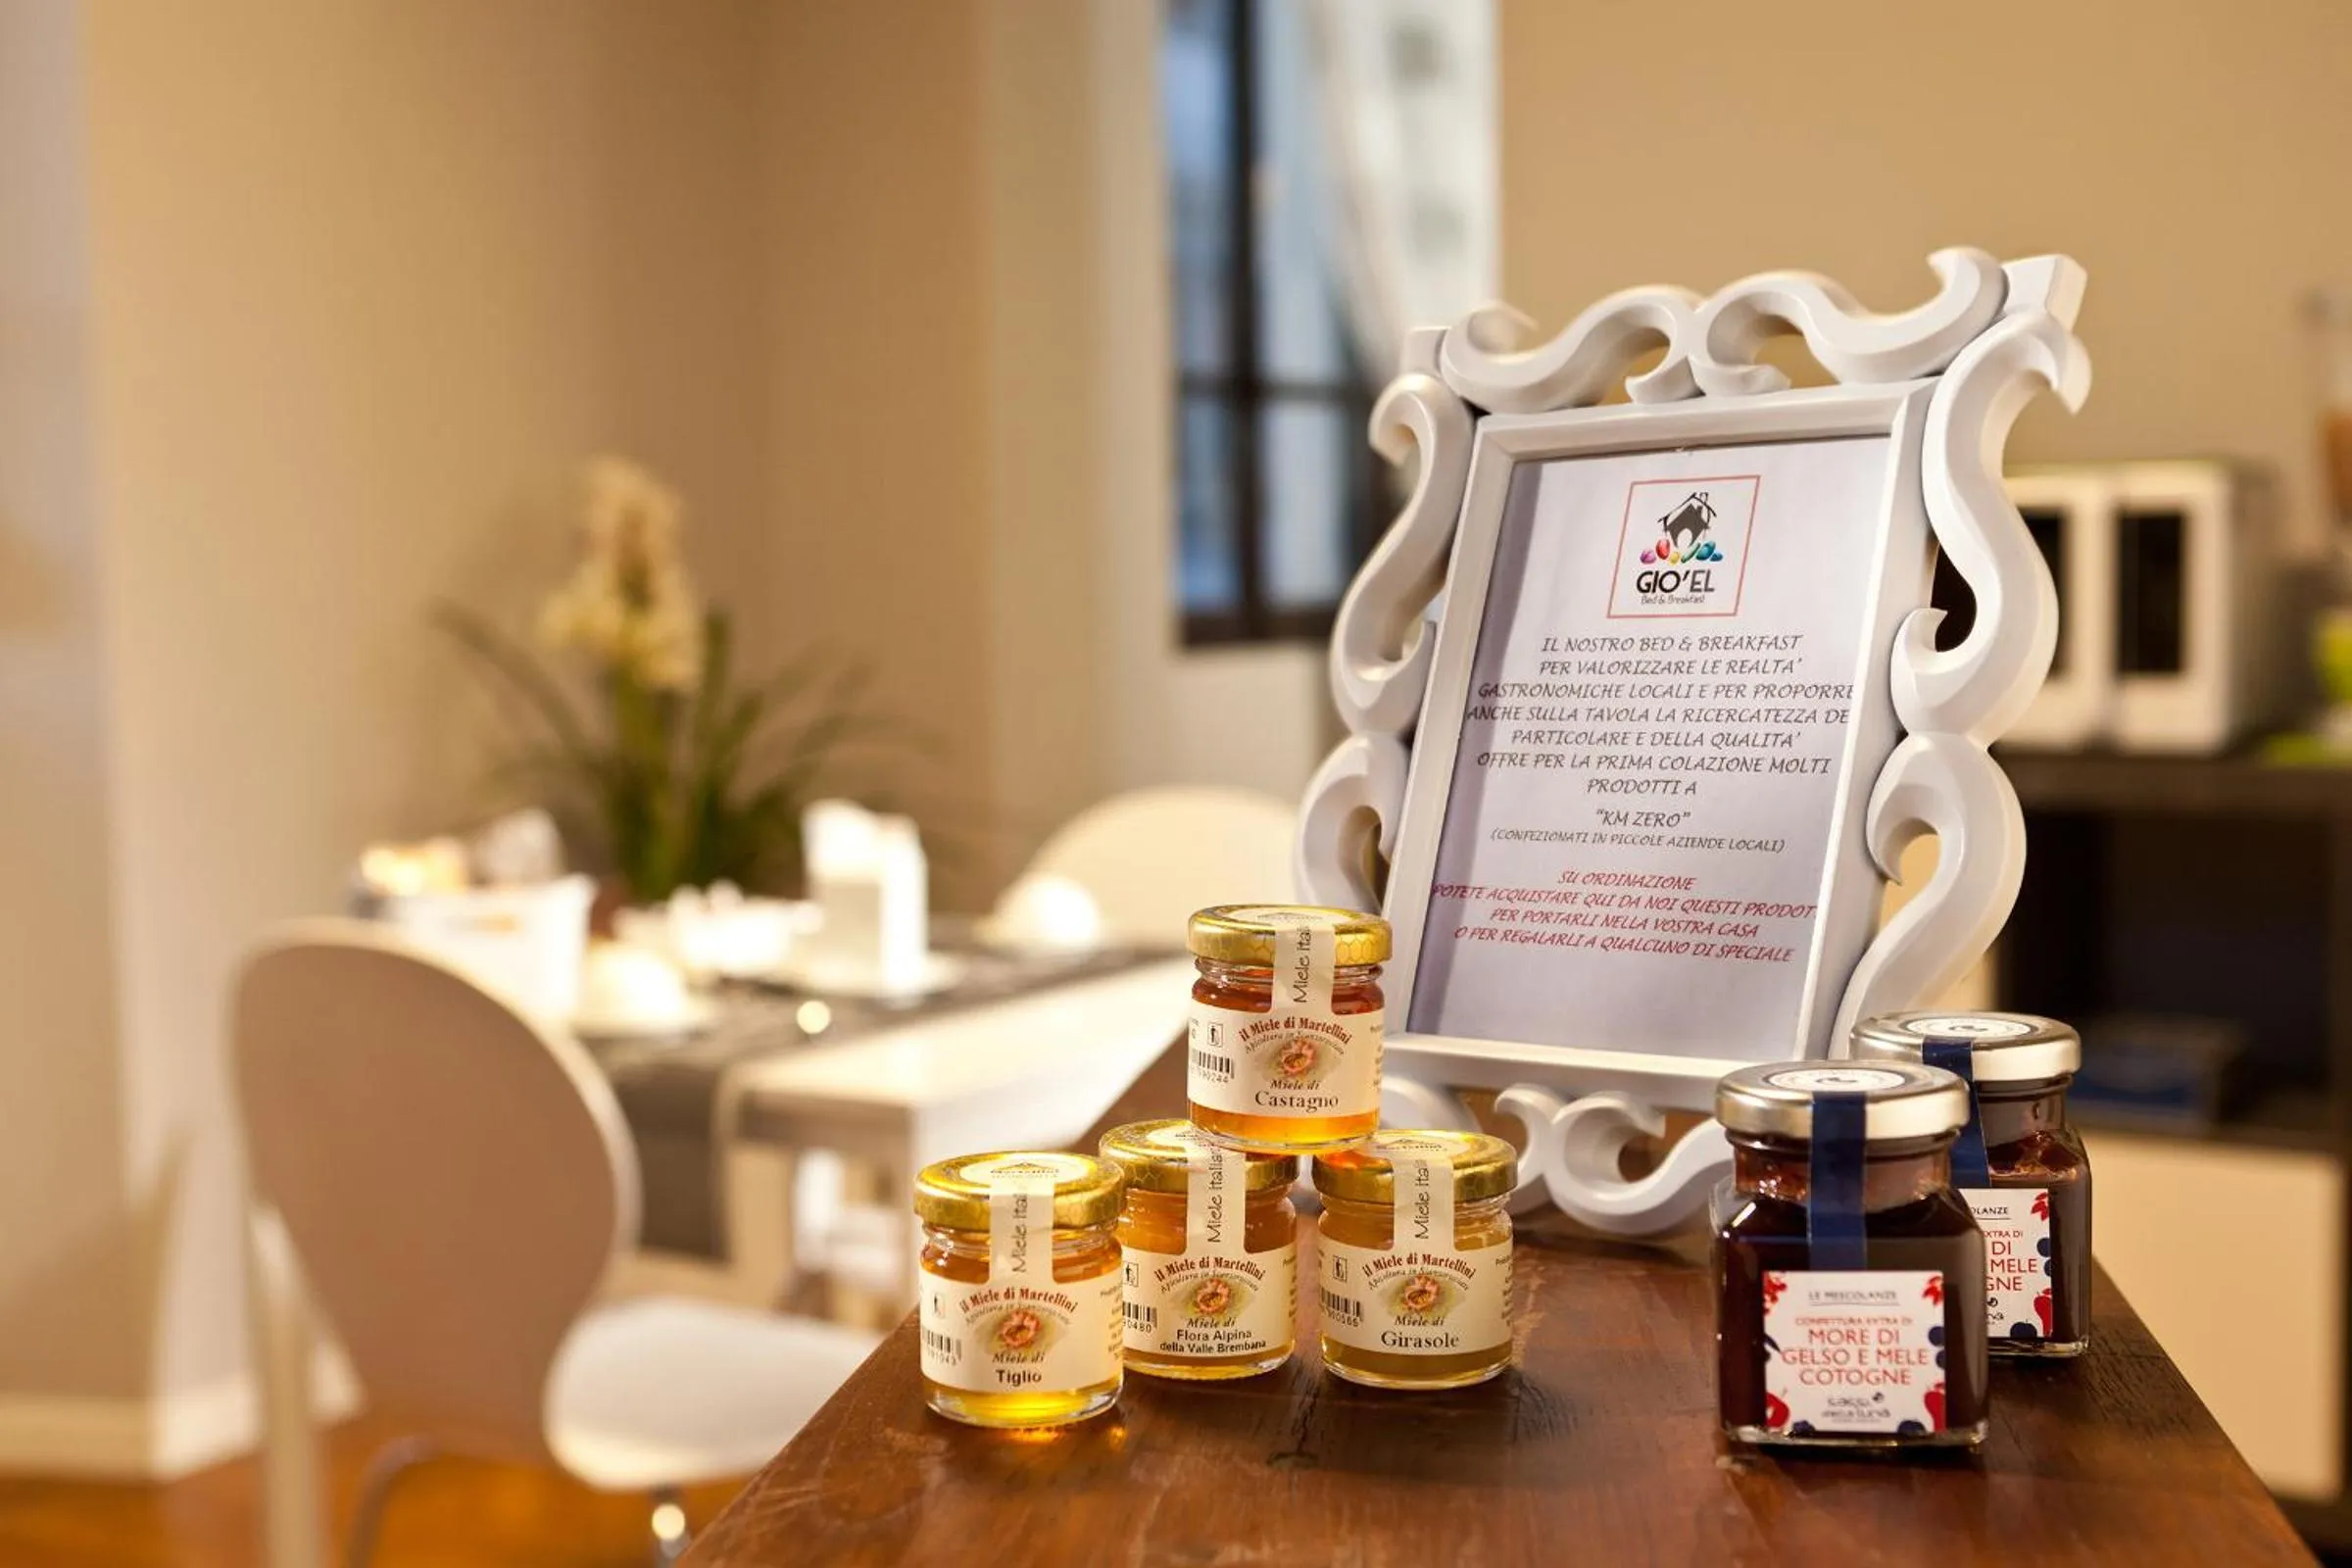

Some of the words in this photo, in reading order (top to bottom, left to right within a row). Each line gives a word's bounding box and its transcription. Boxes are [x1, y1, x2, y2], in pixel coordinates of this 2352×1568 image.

[1636, 569, 1715, 594] GIO'EL
[1641, 595, 1657, 605] Bed
[1658, 595, 1666, 604] &
[1667, 595, 1705, 604] Breakfast
[1542, 637, 1558, 652] IL
[1565, 636, 1634, 653] NOSTRO
[1640, 636, 1675, 652] BED
[1679, 637, 1692, 652] &
[1698, 634, 1803, 652] BREAKFAST
[1540, 660, 1572, 675] PER
[1577, 659, 1696, 675] VALORIZZARE
[1700, 659, 1722, 675] LE
[1478, 682, 1625, 699] GASTRONOMICHE
[1628, 683, 1693, 699] LOCALI
[1698, 684, 1709, 699] E
[1714, 684, 1747, 700] PER
[1466, 706, 1525, 721] ANCHE
[1526, 706, 1578, 721] SULLA
[1585, 707, 1648, 722] TAVOLA
[1655, 707, 1676, 722] LA
[1682, 708, 1816, 724] RICERCATEZZA
[1511, 729, 1633, 746] PARTICOLARE
[1636, 731, 1647, 745] E
[1650, 731, 1704, 747] DELLA
[1477, 752, 1531, 768] OFFRE
[1533, 754, 1566, 768] PER
[1570, 755, 1591, 769] LA
[1595, 755, 1652, 770] PRIMA
[1658, 756, 1764, 772] COLAZIONE
[1768, 757, 1832, 774] MOLTI
[1587, 778, 1682, 795] PRODOTTI
[1685, 781, 1697, 796] A
[1491, 827, 1590, 844] (CONFEZIONATI
[1592, 832, 1607, 844] IN
[1609, 833, 1664, 847] PICCOLE
[1666, 835, 1726, 850] AZIENDE
[1729, 838, 1786, 854] LOCALI)
[1557, 870, 1579, 884] SU
[1582, 872, 1696, 891] ORDINAZIONE
[1486, 887, 1581, 905] ACQUISTARE
[1584, 893, 1615, 908] QUI
[1618, 894, 1642, 908] DA
[1644, 896, 1677, 911] NOI
[1680, 898, 1742, 916] QUESTI
[1742, 902, 1818, 919] PRODOT
[1490, 907, 1520, 922] PER
[1521, 909, 1599, 927] PORTARLI
[1600, 913, 1648, 931] NELLA
[1652, 917, 1714, 936] VOSTRA
[1717, 922, 1760, 938] CASA
[1454, 926, 1468, 940] O
[1470, 928, 1495, 941] PER
[1499, 929, 1585, 948] REGALARLI
[1584, 936, 1596, 950] A
[1600, 936, 1690, 955] QUALCUNO
[1692, 942, 1716, 957] DI
[1715, 944, 1795, 962] SPECIALE
[1293, 955, 1310, 1004] Miele
[1239, 1028, 1250, 1042] il
[1250, 1018, 1280, 1035] Miele
[1284, 1016, 1296, 1028] di
[1299, 1017, 1352, 1045] Martellini
[1270, 1079, 1301, 1090] Miele
[1307, 1079, 1320, 1090] di
[1255, 1090, 1339, 1113] Castagno
[1206, 1195, 1223, 1243] Miele
[1413, 1192, 1431, 1240] Miele
[1010, 1224, 1027, 1273] Miele
[1991, 1241, 2012, 1255] DI
[1165, 1258, 1196, 1275] Miele
[1200, 1256, 1210, 1269] di
[1214, 1256, 1266, 1281] Martellini
[1362, 1263, 1372, 1277] il
[1372, 1254, 1403, 1271] Miele
[1406, 1252, 1418, 1265] di
[1422, 1253, 1477, 1280] Martellini
[1990, 1258, 2038, 1274] MELE
[970, 1289, 1000, 1306] Miele
[1004, 1286, 1015, 1299] di
[1019, 1288, 1079, 1313] Martellini
[1187, 1318, 1218, 1328] Miele
[1224, 1317, 1236, 1328] di
[1395, 1315, 1429, 1326] Miele
[1432, 1315, 1445, 1326] di
[1177, 1329, 1209, 1342] Flora
[1213, 1330, 1251, 1343] Alpina
[1381, 1331, 1459, 1348] Girasole
[1807, 1329, 1870, 1346] MORE
[1878, 1329, 1900, 1346] DI
[1160, 1341, 1184, 1352] della
[1188, 1343, 1214, 1353] Valle
[1217, 1340, 1266, 1352] Brembana
[992, 1352, 1027, 1363] Miele
[1031, 1351, 1045, 1363] di
[1780, 1348, 1851, 1366] GELSO
[1858, 1348, 1870, 1365] E
[1876, 1348, 1930, 1365] MELE
[996, 1369, 1042, 1387] Tiglio
[1798, 1368, 1913, 1386] COTOGNE
